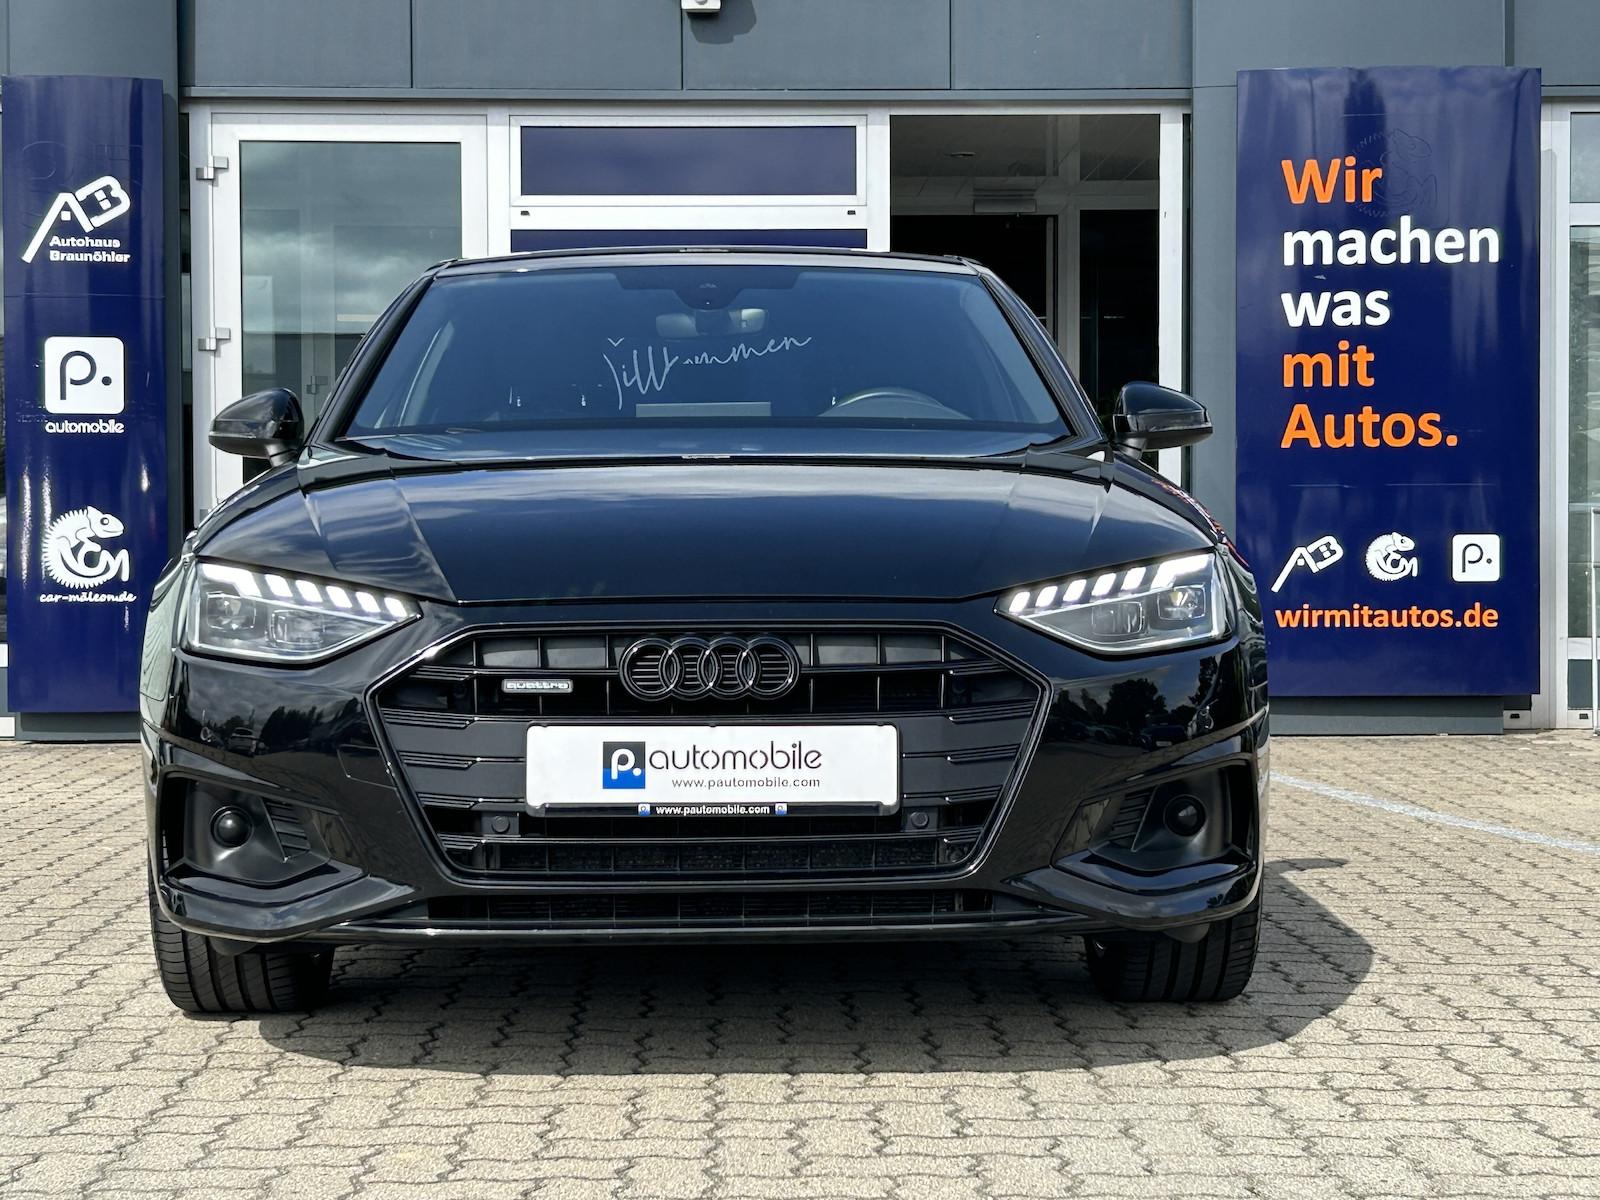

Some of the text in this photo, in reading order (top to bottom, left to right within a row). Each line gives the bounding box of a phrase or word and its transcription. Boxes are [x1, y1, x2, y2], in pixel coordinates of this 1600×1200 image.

[1280, 155, 1384, 205] Wir
[49, 235, 121, 248] Autohaus
[1282, 215, 1501, 267] machen
[49, 250, 131, 263] Braunöhler
[1280, 289, 1391, 327] was
[1282, 339, 1375, 388] mit
[45, 418, 125, 434] automobile
[1280, 403, 1458, 449] Autos.
[1274, 601, 1499, 628] wirmitautos.de
[506, 680, 569, 690] quattro
[649, 741, 823, 770] automobile
[671, 777, 821, 790] www.pautomobile.com
[655, 803, 771, 816] www.pautomobile.com
